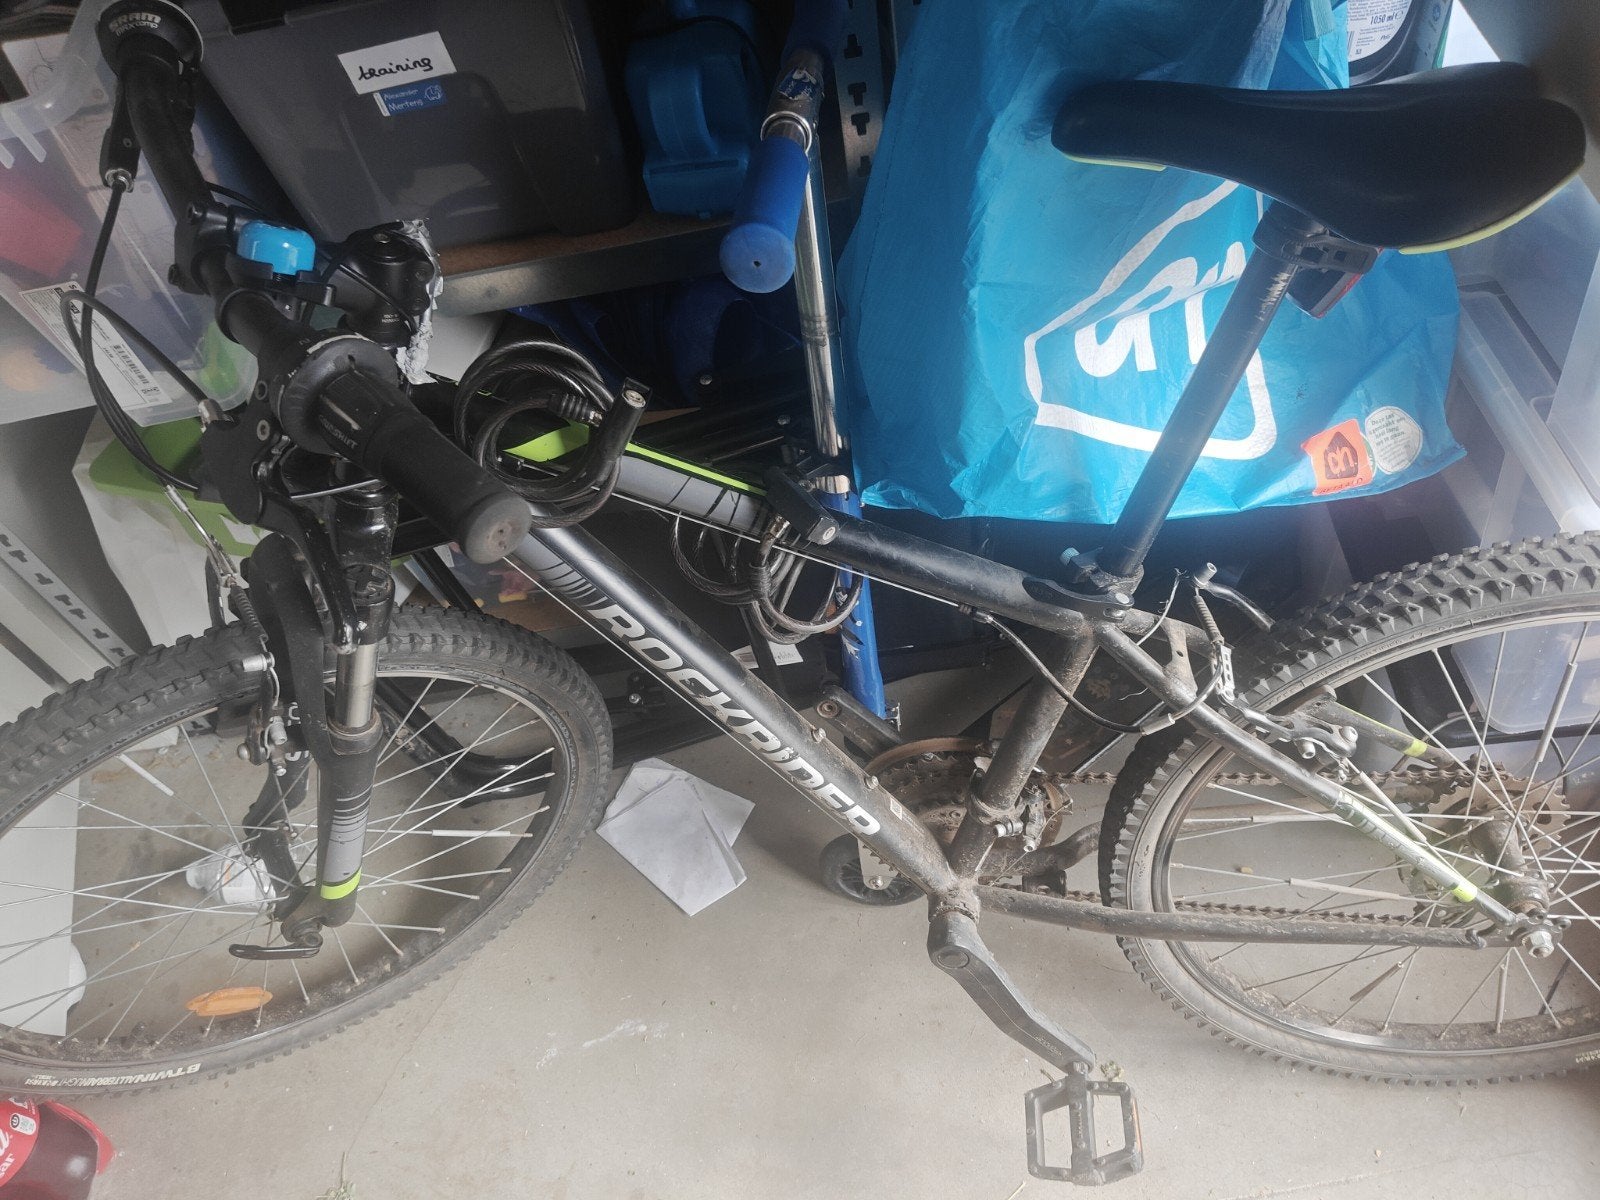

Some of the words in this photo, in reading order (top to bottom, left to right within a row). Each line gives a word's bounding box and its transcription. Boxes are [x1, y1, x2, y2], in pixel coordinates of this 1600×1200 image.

[109, 12, 161, 32] SRAM
[1370, 14, 1385, 25] 1050
[358, 57, 434, 81] training
[588, 603, 881, 836] ROCKRIDER
